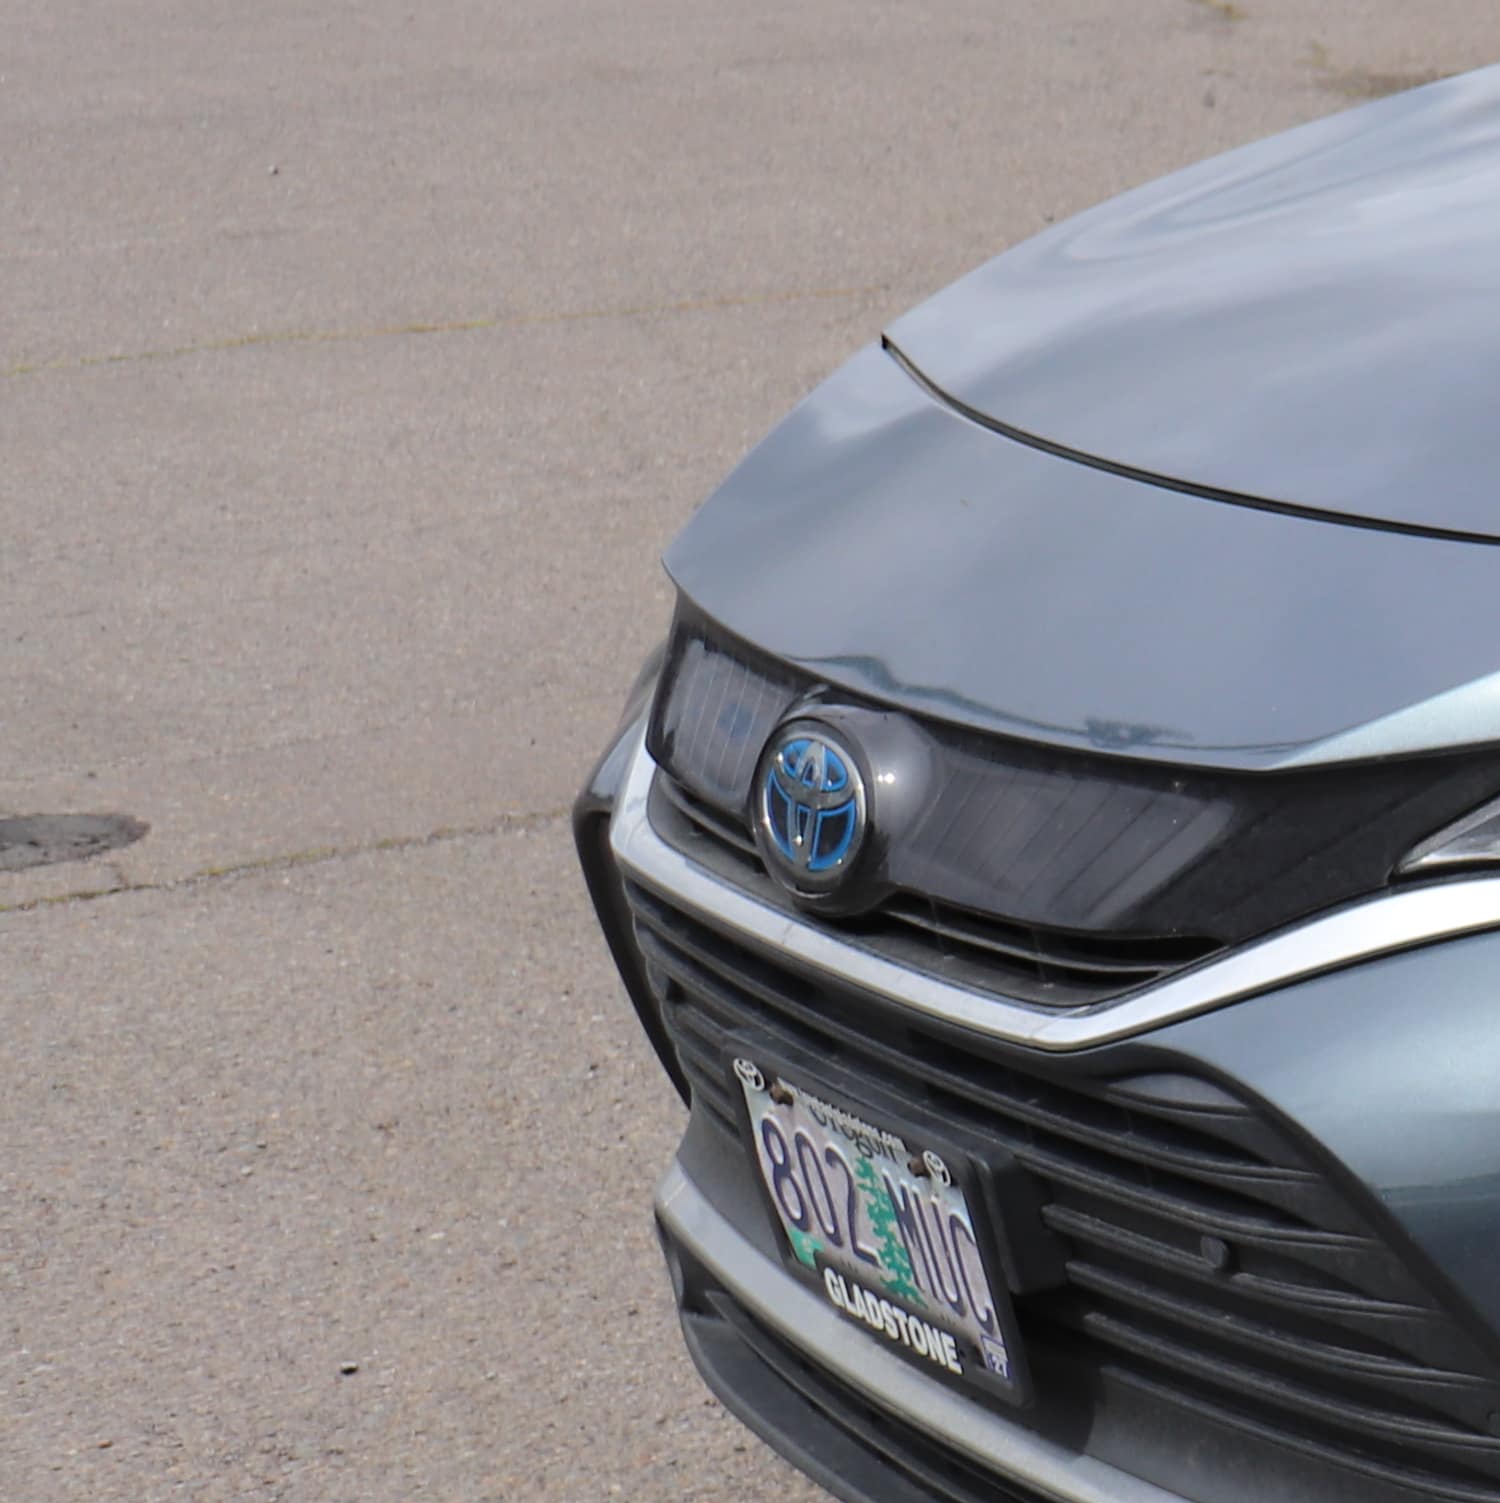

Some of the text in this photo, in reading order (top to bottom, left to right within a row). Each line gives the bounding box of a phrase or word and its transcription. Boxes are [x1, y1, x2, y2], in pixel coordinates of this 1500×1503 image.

[761, 1115, 882, 1268] 802
[882, 1170, 995, 1334] MUC
[823, 1266, 963, 1375] GLADSTONE
